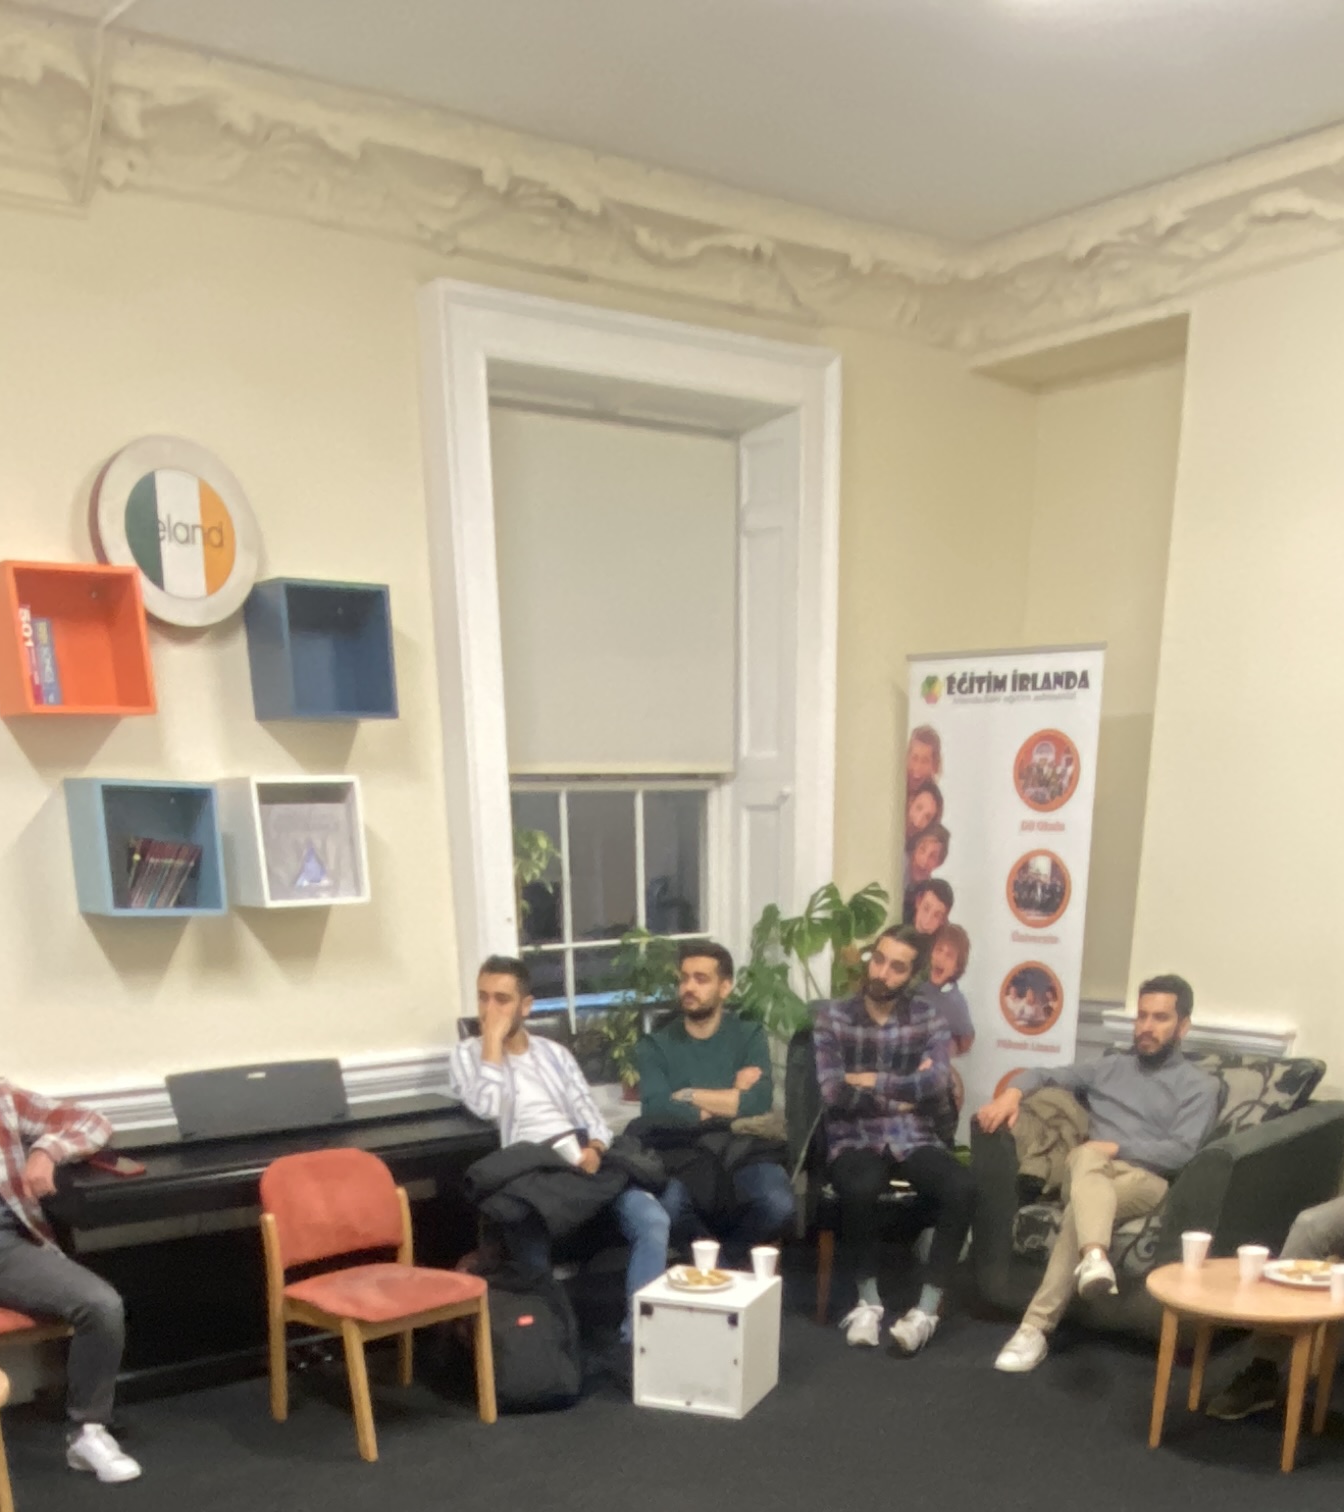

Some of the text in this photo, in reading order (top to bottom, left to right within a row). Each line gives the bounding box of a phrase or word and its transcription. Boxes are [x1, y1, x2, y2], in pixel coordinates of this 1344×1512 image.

[157, 513, 224, 549] eland
[946, 669, 1090, 695] EĞİTİM İRLANDA
